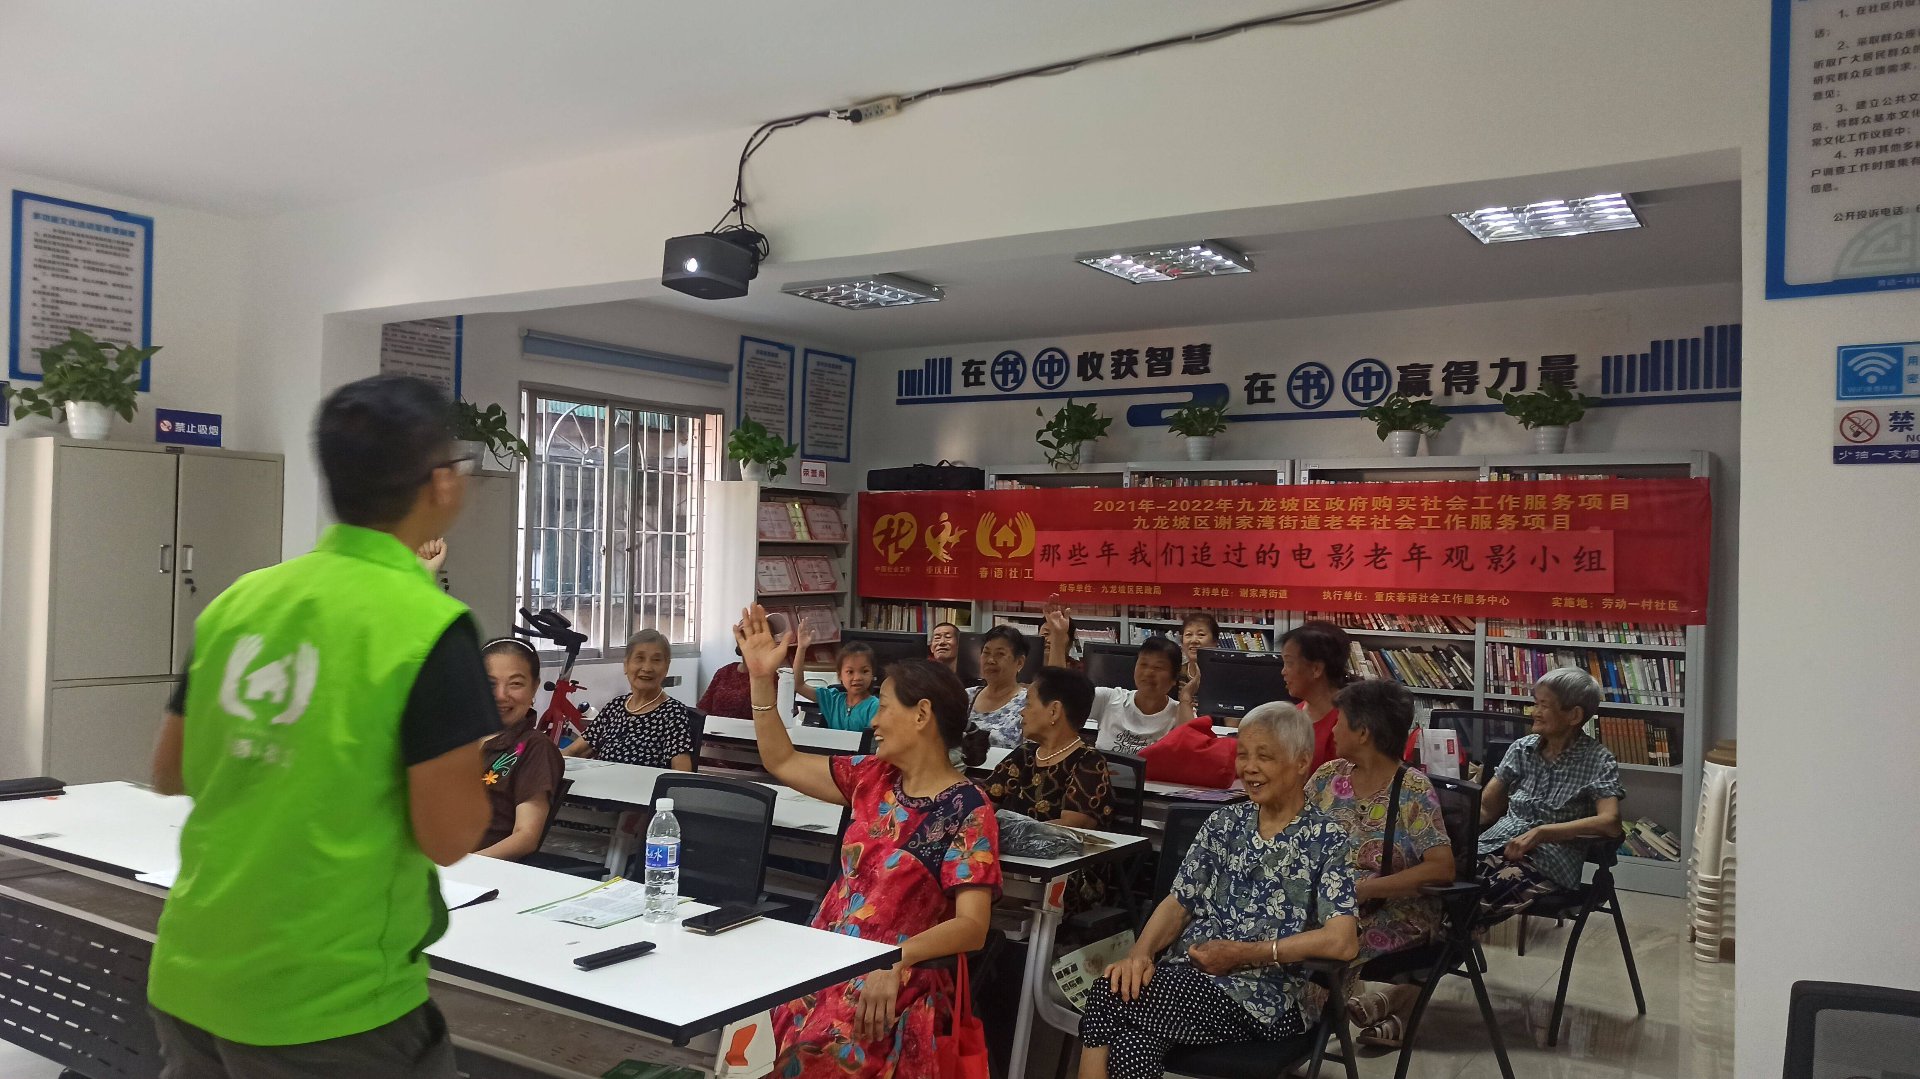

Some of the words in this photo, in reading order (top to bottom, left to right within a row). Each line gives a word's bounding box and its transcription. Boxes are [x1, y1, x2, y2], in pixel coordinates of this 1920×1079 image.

[961, 343, 1213, 391] 在书中收获智慧
[1244, 354, 1579, 407] 在书中赢得力量
[174, 422, 219, 436] 禁止吸烟
[1888, 410, 1915, 433] 禁
[1133, 514, 1571, 530] 九龙坡区谢家湾街道老年社会工作服务项目
[1039, 541, 1608, 573] 那些年我们追过的电影老年观影小组
